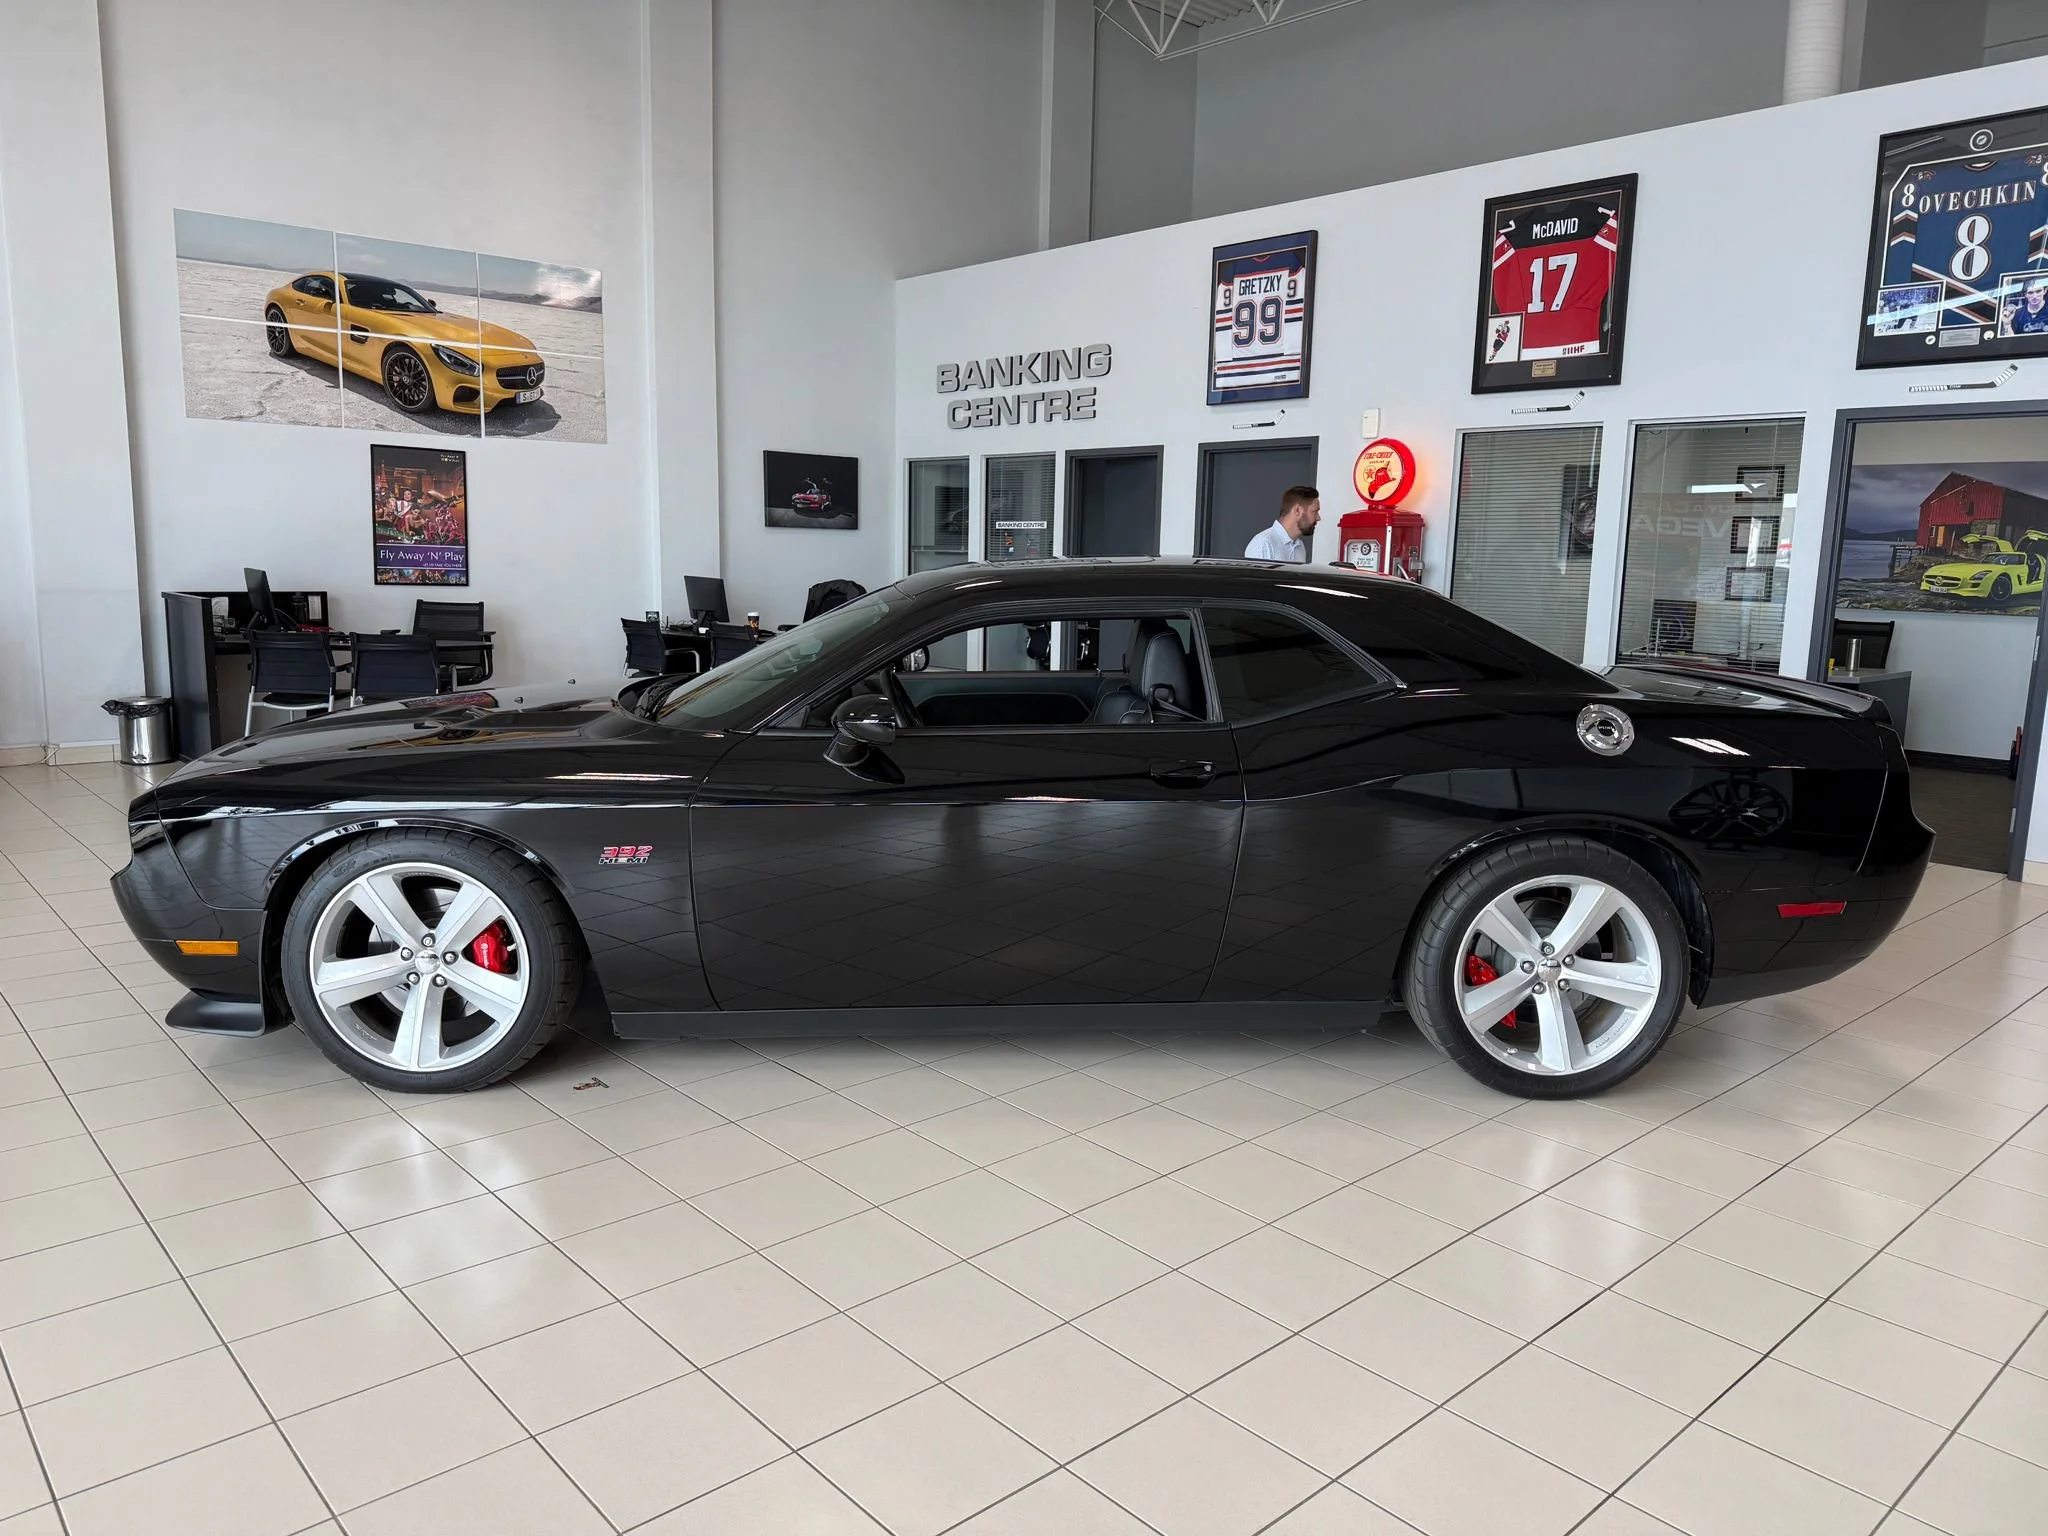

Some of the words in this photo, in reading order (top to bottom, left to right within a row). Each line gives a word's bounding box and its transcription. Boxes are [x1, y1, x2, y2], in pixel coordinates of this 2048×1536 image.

[1901, 183, 1916, 208] 8
[1918, 181, 2037, 214] OVECHKIN
[1532, 217, 1579, 240] McDAVID
[1950, 213, 1992, 282] 8
[1238, 274, 1283, 297] GRETZKY
[1286, 279, 1297, 299] 9
[1527, 252, 1579, 314] 17
[1223, 288, 1232, 307] 9
[1231, 295, 1284, 348] 99
[936, 343, 1112, 394] BANKING
[947, 386, 1097, 430] CENTRE
[380, 549, 395, 561] Fly
[397, 551, 425, 562] Away
[444, 551, 464, 563] Play
[598, 856, 649, 865] HEMI
[600, 845, 653, 858] 392
